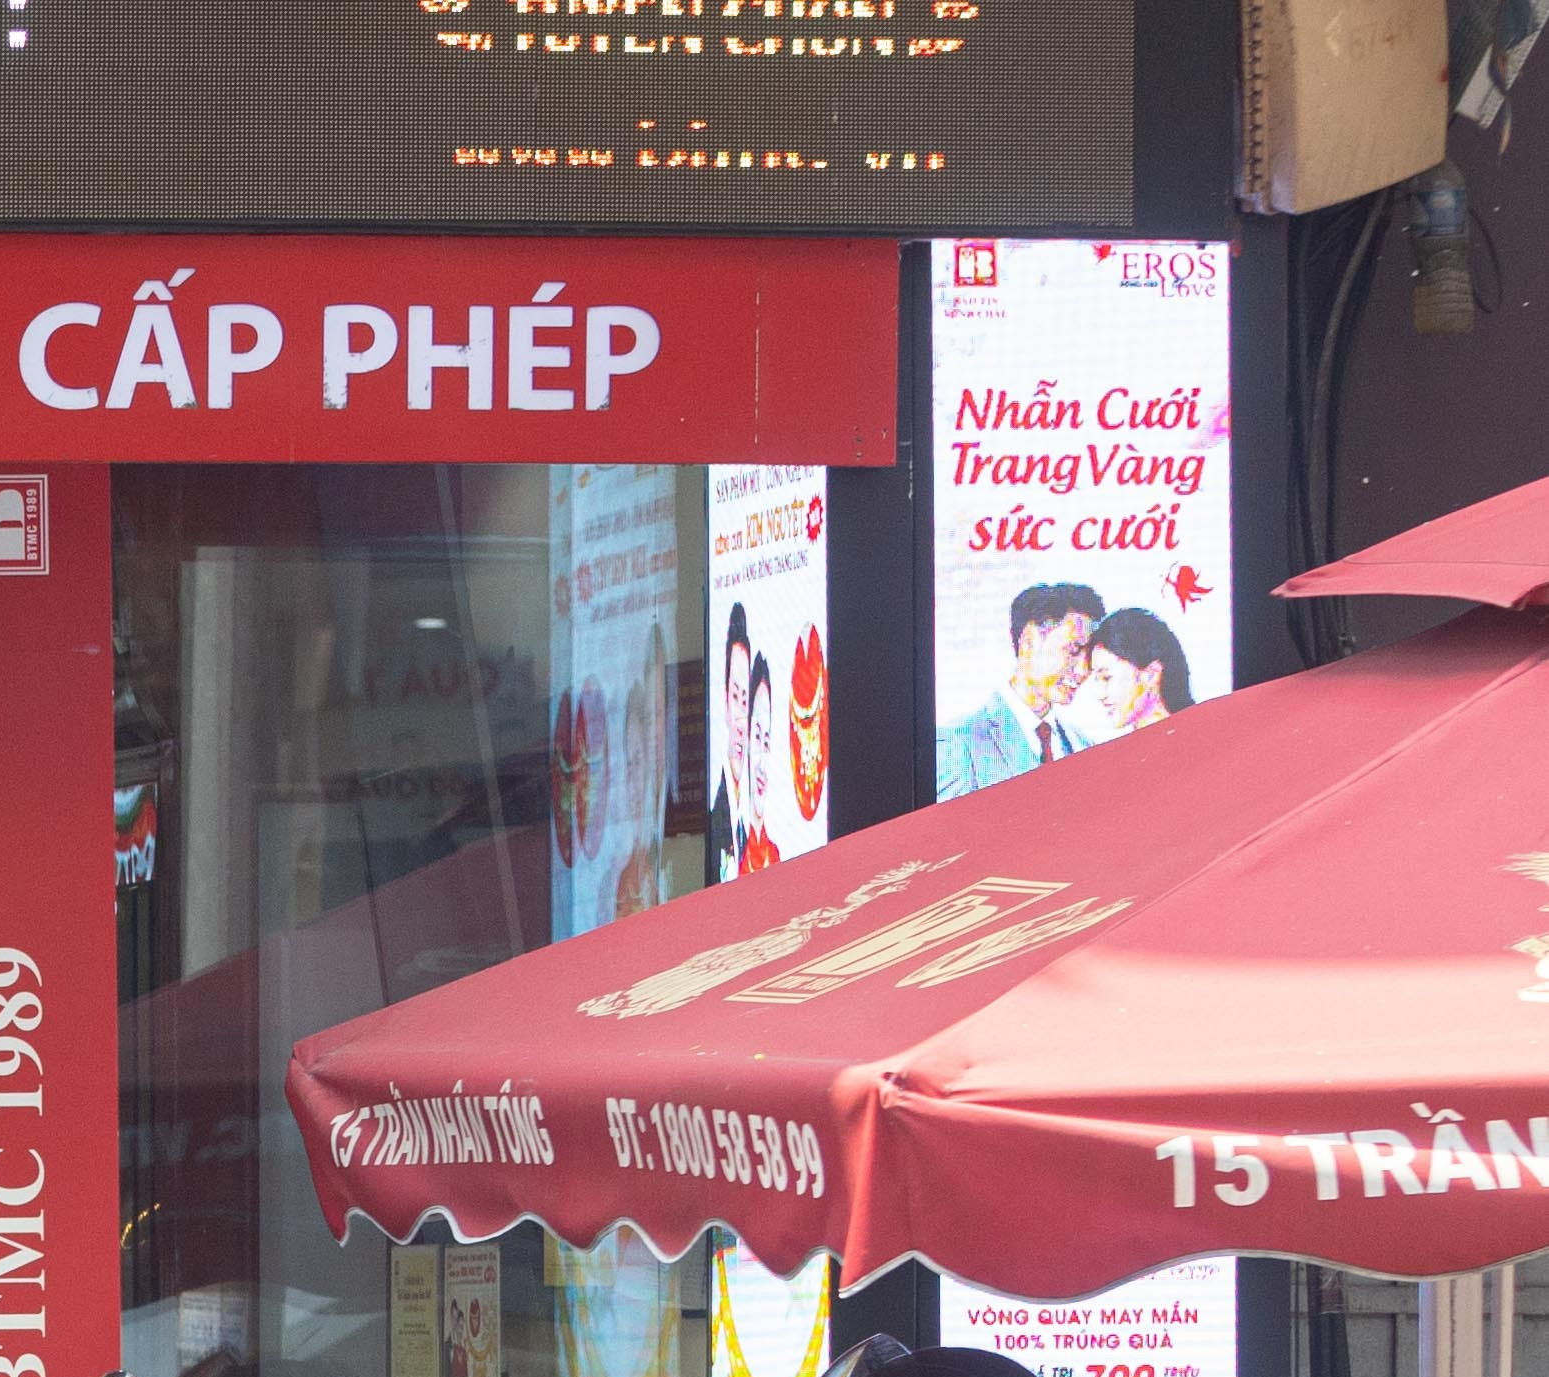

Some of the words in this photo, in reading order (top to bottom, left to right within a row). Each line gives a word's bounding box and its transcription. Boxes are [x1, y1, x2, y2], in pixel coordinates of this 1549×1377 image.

[1122, 253, 1215, 279] EROS
[19, 267, 284, 412] CẤP
[323, 281, 661, 412] PHÉP
[955, 380, 1083, 430] Nhẫn
[1097, 388, 1200, 430] Cưới
[951, 442, 1081, 494] Trang
[1087, 444, 1205, 495] Vàng
[26, 488, 37, 519] 1989
[969, 503, 1055, 551] sức
[1071, 503, 1180, 550] cưới
[26, 524, 37, 560] BTMC
[330, 1106, 371, 1168] 15
[362, 1082, 429, 1166] TRẦN
[423, 1079, 484, 1165] NHÂN
[483, 1079, 554, 1165] TÔNG
[606, 1098, 654, 1170] ĐT:
[650, 1102, 715, 1179] 1800
[712, 1109, 751, 1185] 58
[748, 1114, 788, 1192] 58
[787, 1121, 825, 1199] 99
[1155, 1132, 1271, 1209] 15
[1038, 1309, 1093, 1325] QUAY
[1100, 1309, 1145, 1325] MAY
[994, 1334, 1045, 1351] 100%
